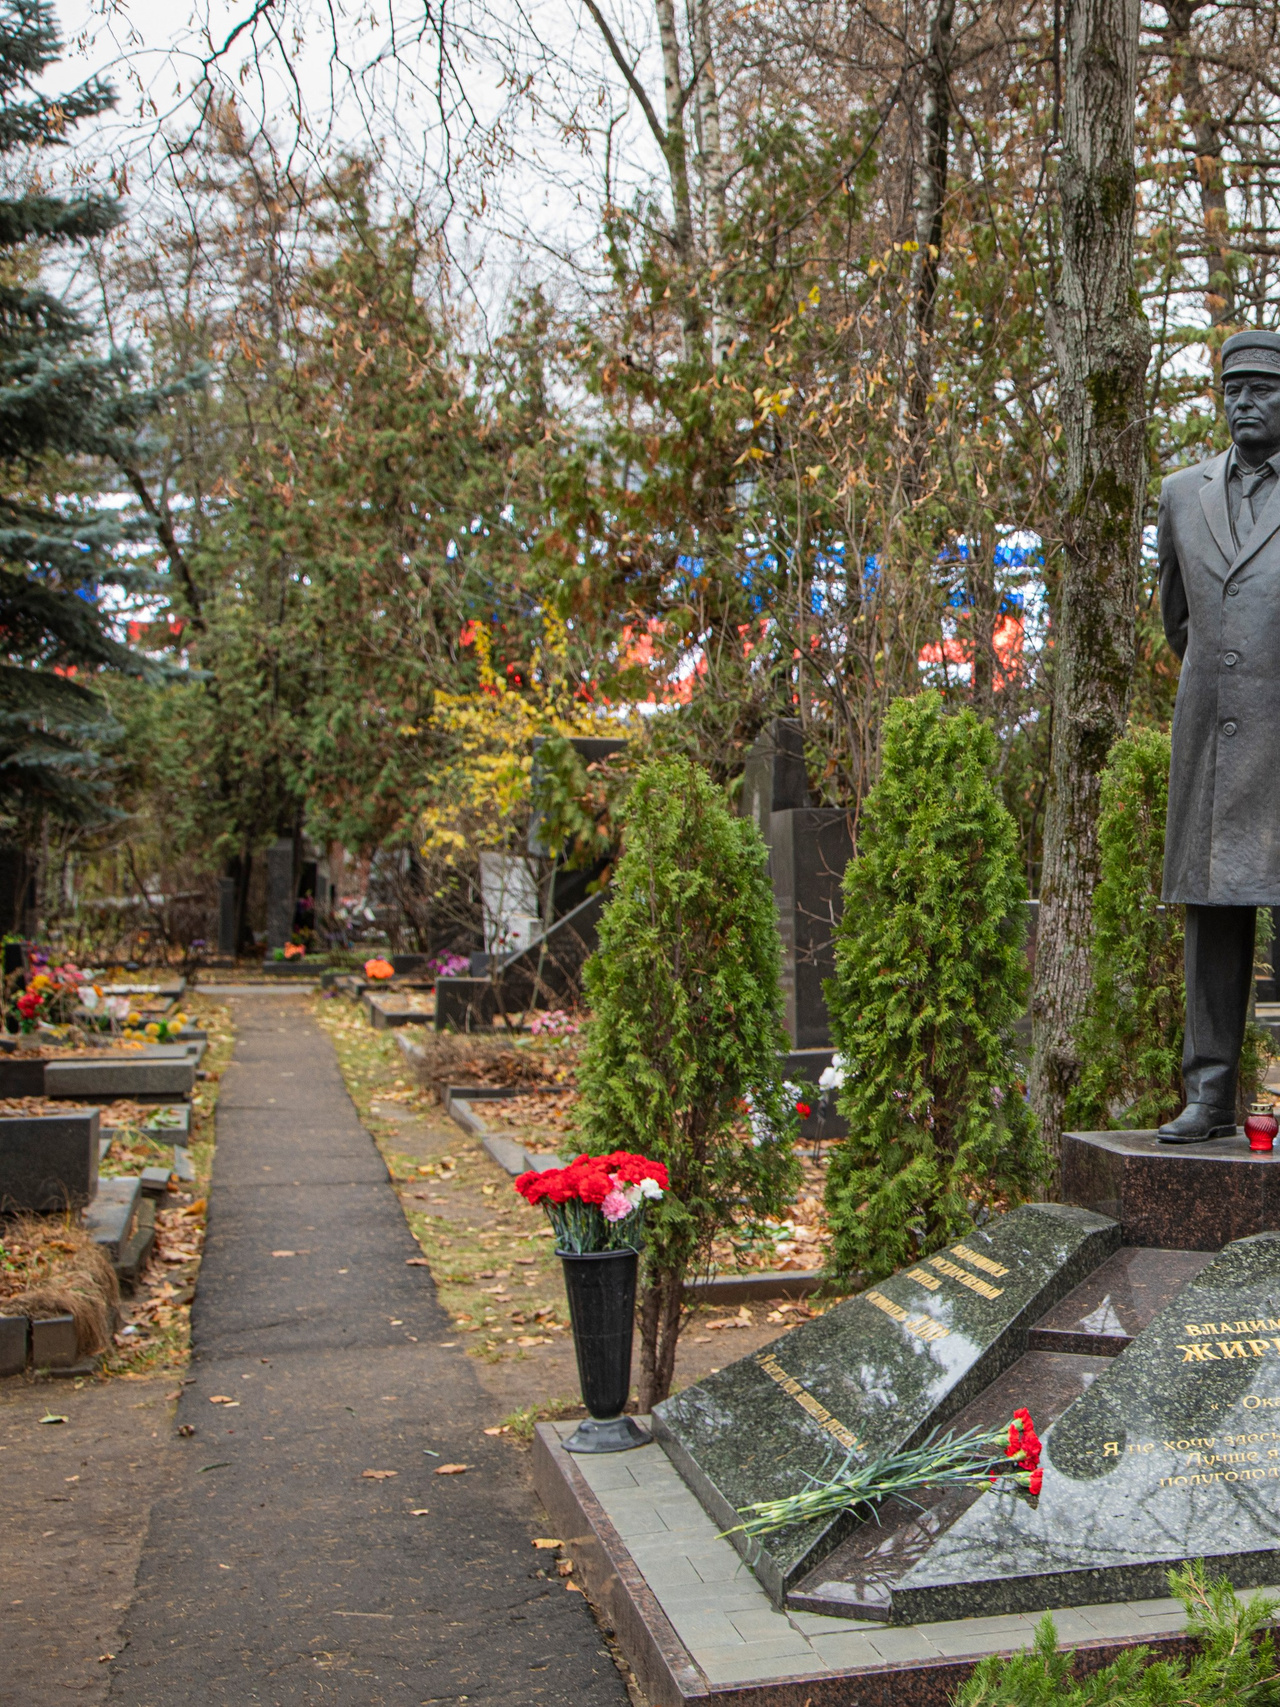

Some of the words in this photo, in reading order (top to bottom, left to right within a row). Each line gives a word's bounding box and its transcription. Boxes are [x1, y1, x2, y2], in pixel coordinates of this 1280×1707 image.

[1102, 1441, 1119, 1457] Я
[1127, 1442, 1155, 1455] не
[1162, 1436, 1216, 1452] хочу
[1186, 1451, 1259, 1469] Лучше
[1266, 1447, 1280, 1460] я
